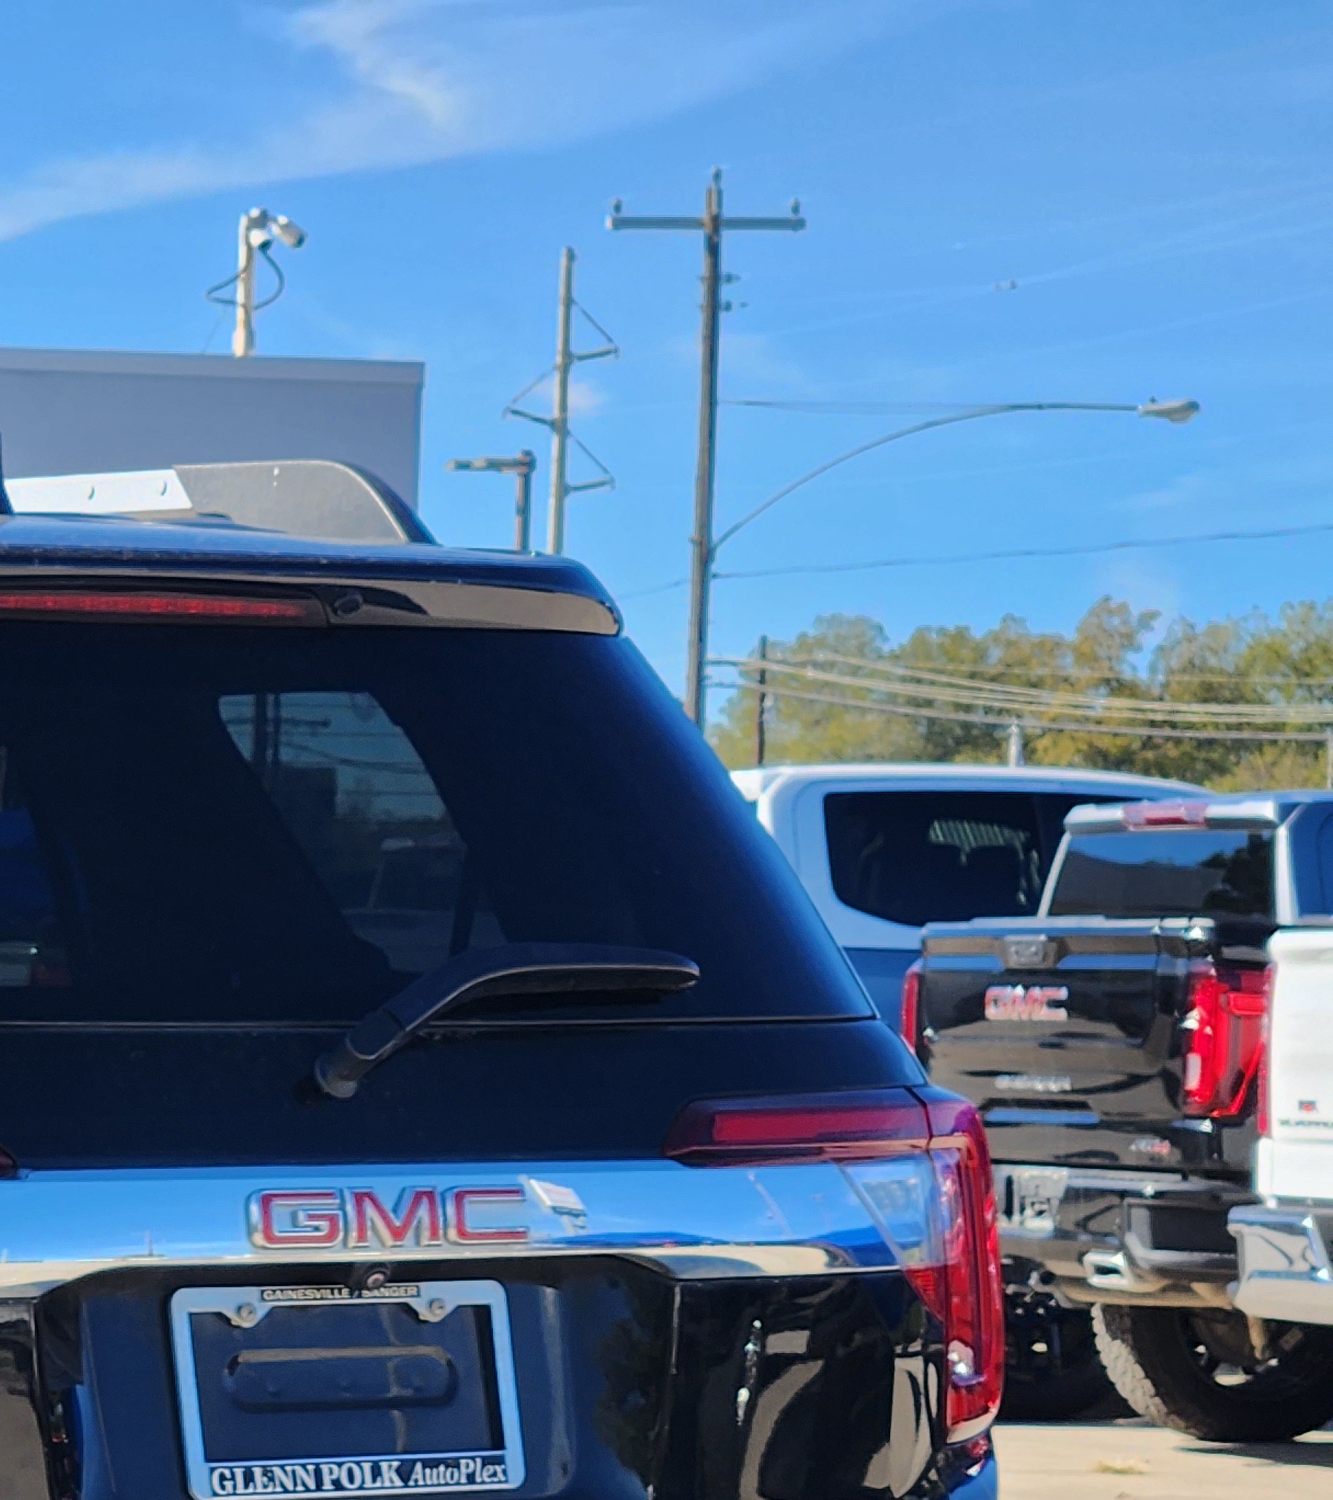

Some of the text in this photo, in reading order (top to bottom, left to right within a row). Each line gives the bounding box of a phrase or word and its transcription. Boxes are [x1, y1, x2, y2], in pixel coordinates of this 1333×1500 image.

[984, 984, 1069, 1021] GMC
[246, 1184, 530, 1250] GMC
[262, 1287, 351, 1300] GAINESVILLE
[210, 1456, 508, 1496] GLENN POLK AutoPlex
